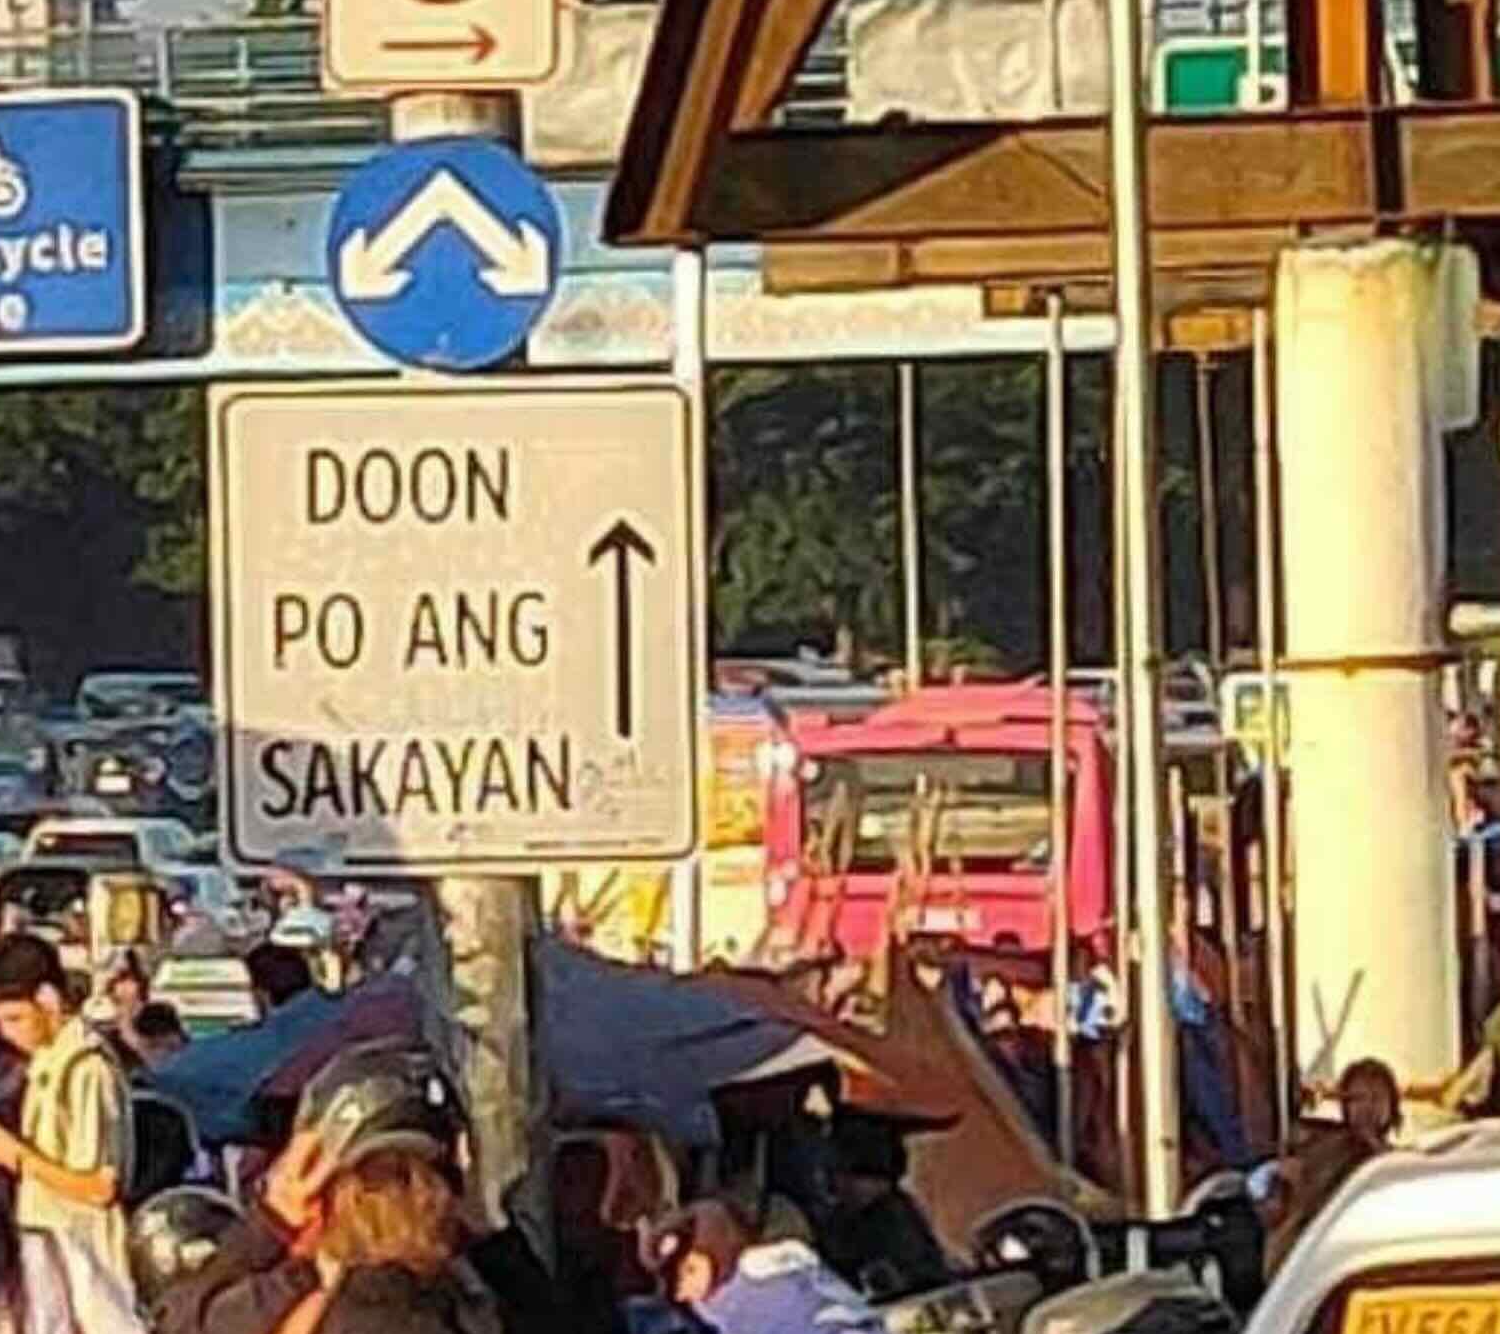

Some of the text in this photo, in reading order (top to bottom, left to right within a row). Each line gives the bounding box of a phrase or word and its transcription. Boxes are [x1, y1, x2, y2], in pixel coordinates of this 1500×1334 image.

[306, 447, 510, 523] DOON
[273, 590, 550, 670] PO ANG
[260, 735, 573, 819] SAKAYAN
